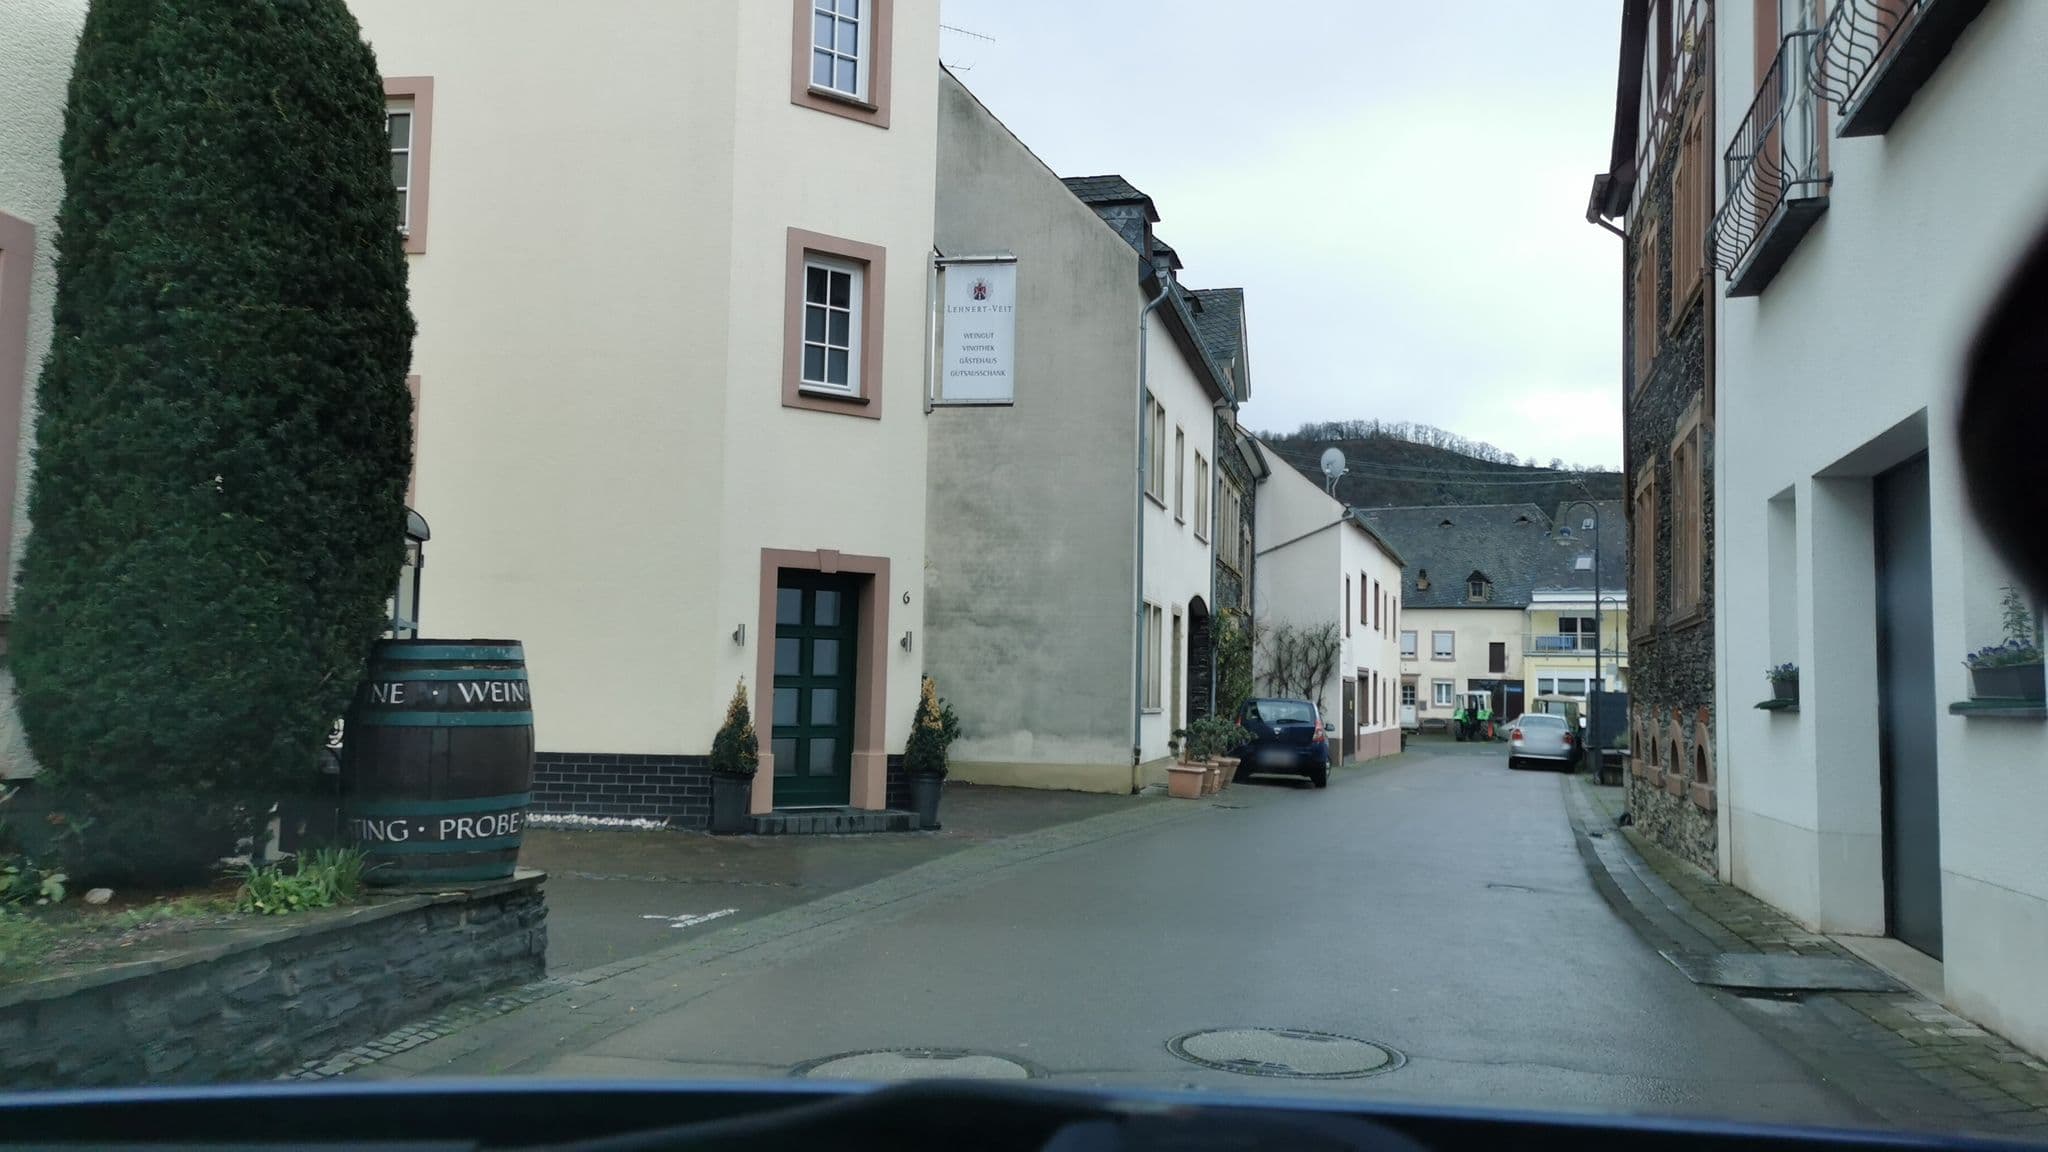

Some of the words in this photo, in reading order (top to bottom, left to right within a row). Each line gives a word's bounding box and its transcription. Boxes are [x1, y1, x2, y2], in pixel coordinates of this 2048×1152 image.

[959, 356, 998, 365] GÄSTEHAUS
[903, 590, 910, 605] 6
[439, 812, 520, 841] PROBE
